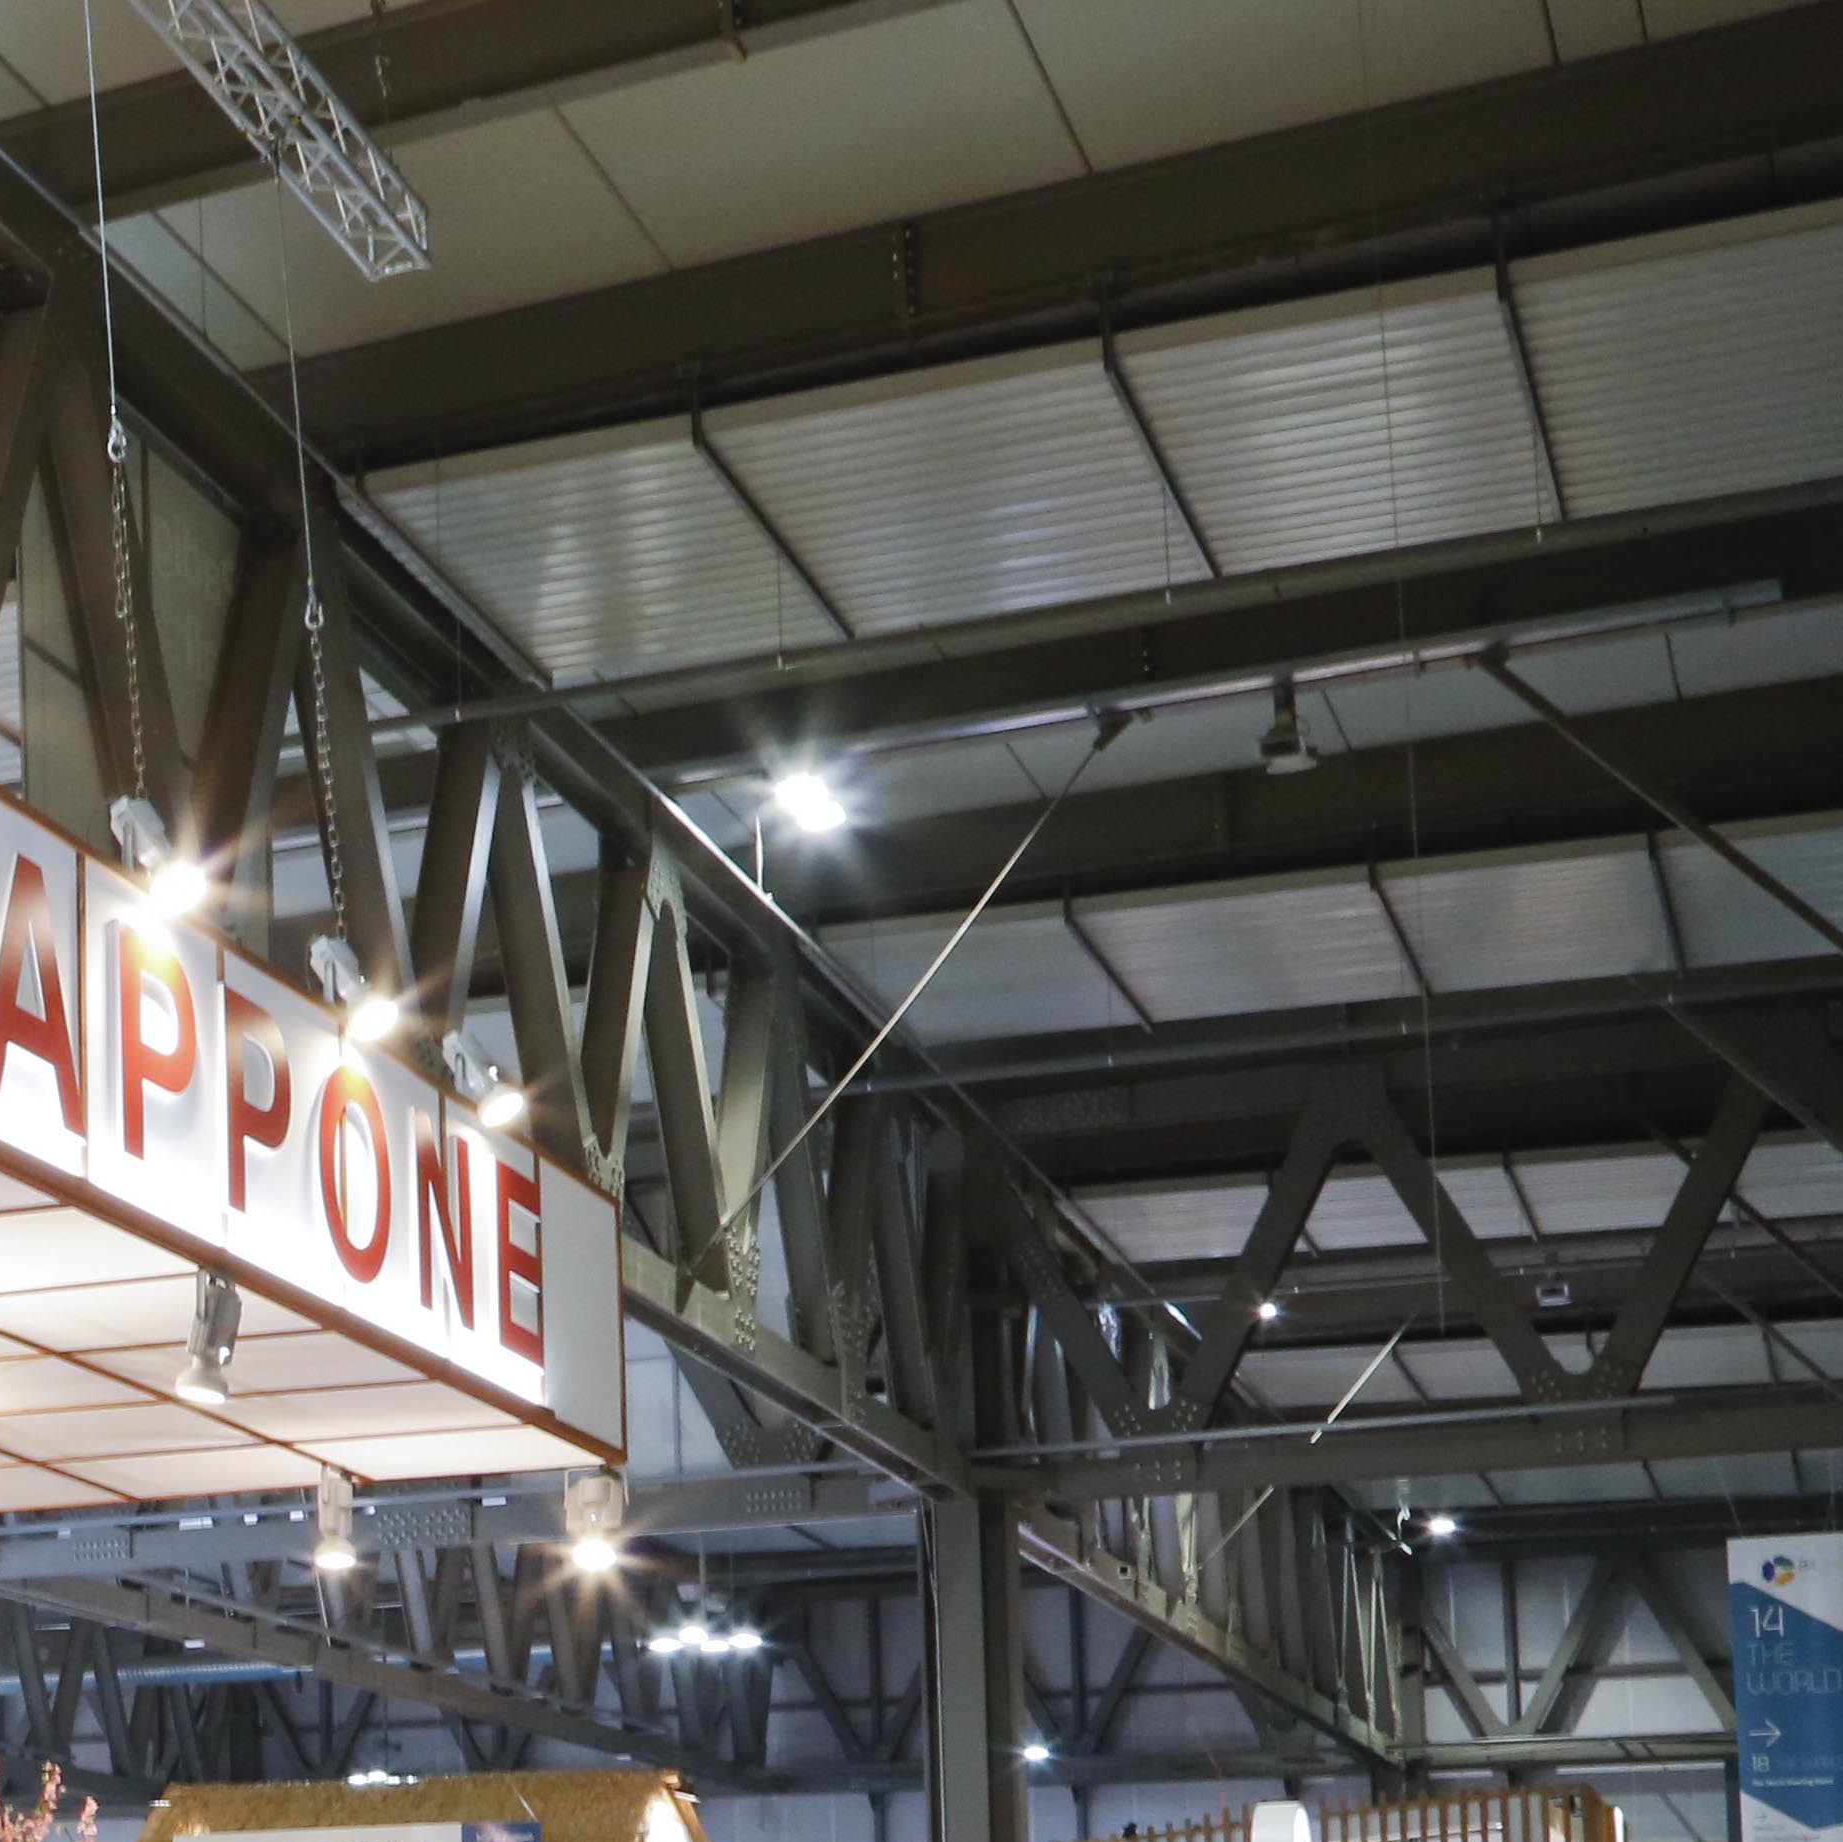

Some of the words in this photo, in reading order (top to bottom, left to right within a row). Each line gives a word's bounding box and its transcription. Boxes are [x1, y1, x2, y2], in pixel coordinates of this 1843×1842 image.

[1750, 1605, 1785, 1638] 14
[1747, 1643, 1794, 1666] THE
[1745, 1669, 1841, 1696] WORLD
[1751, 1752, 1770, 1773] 18
